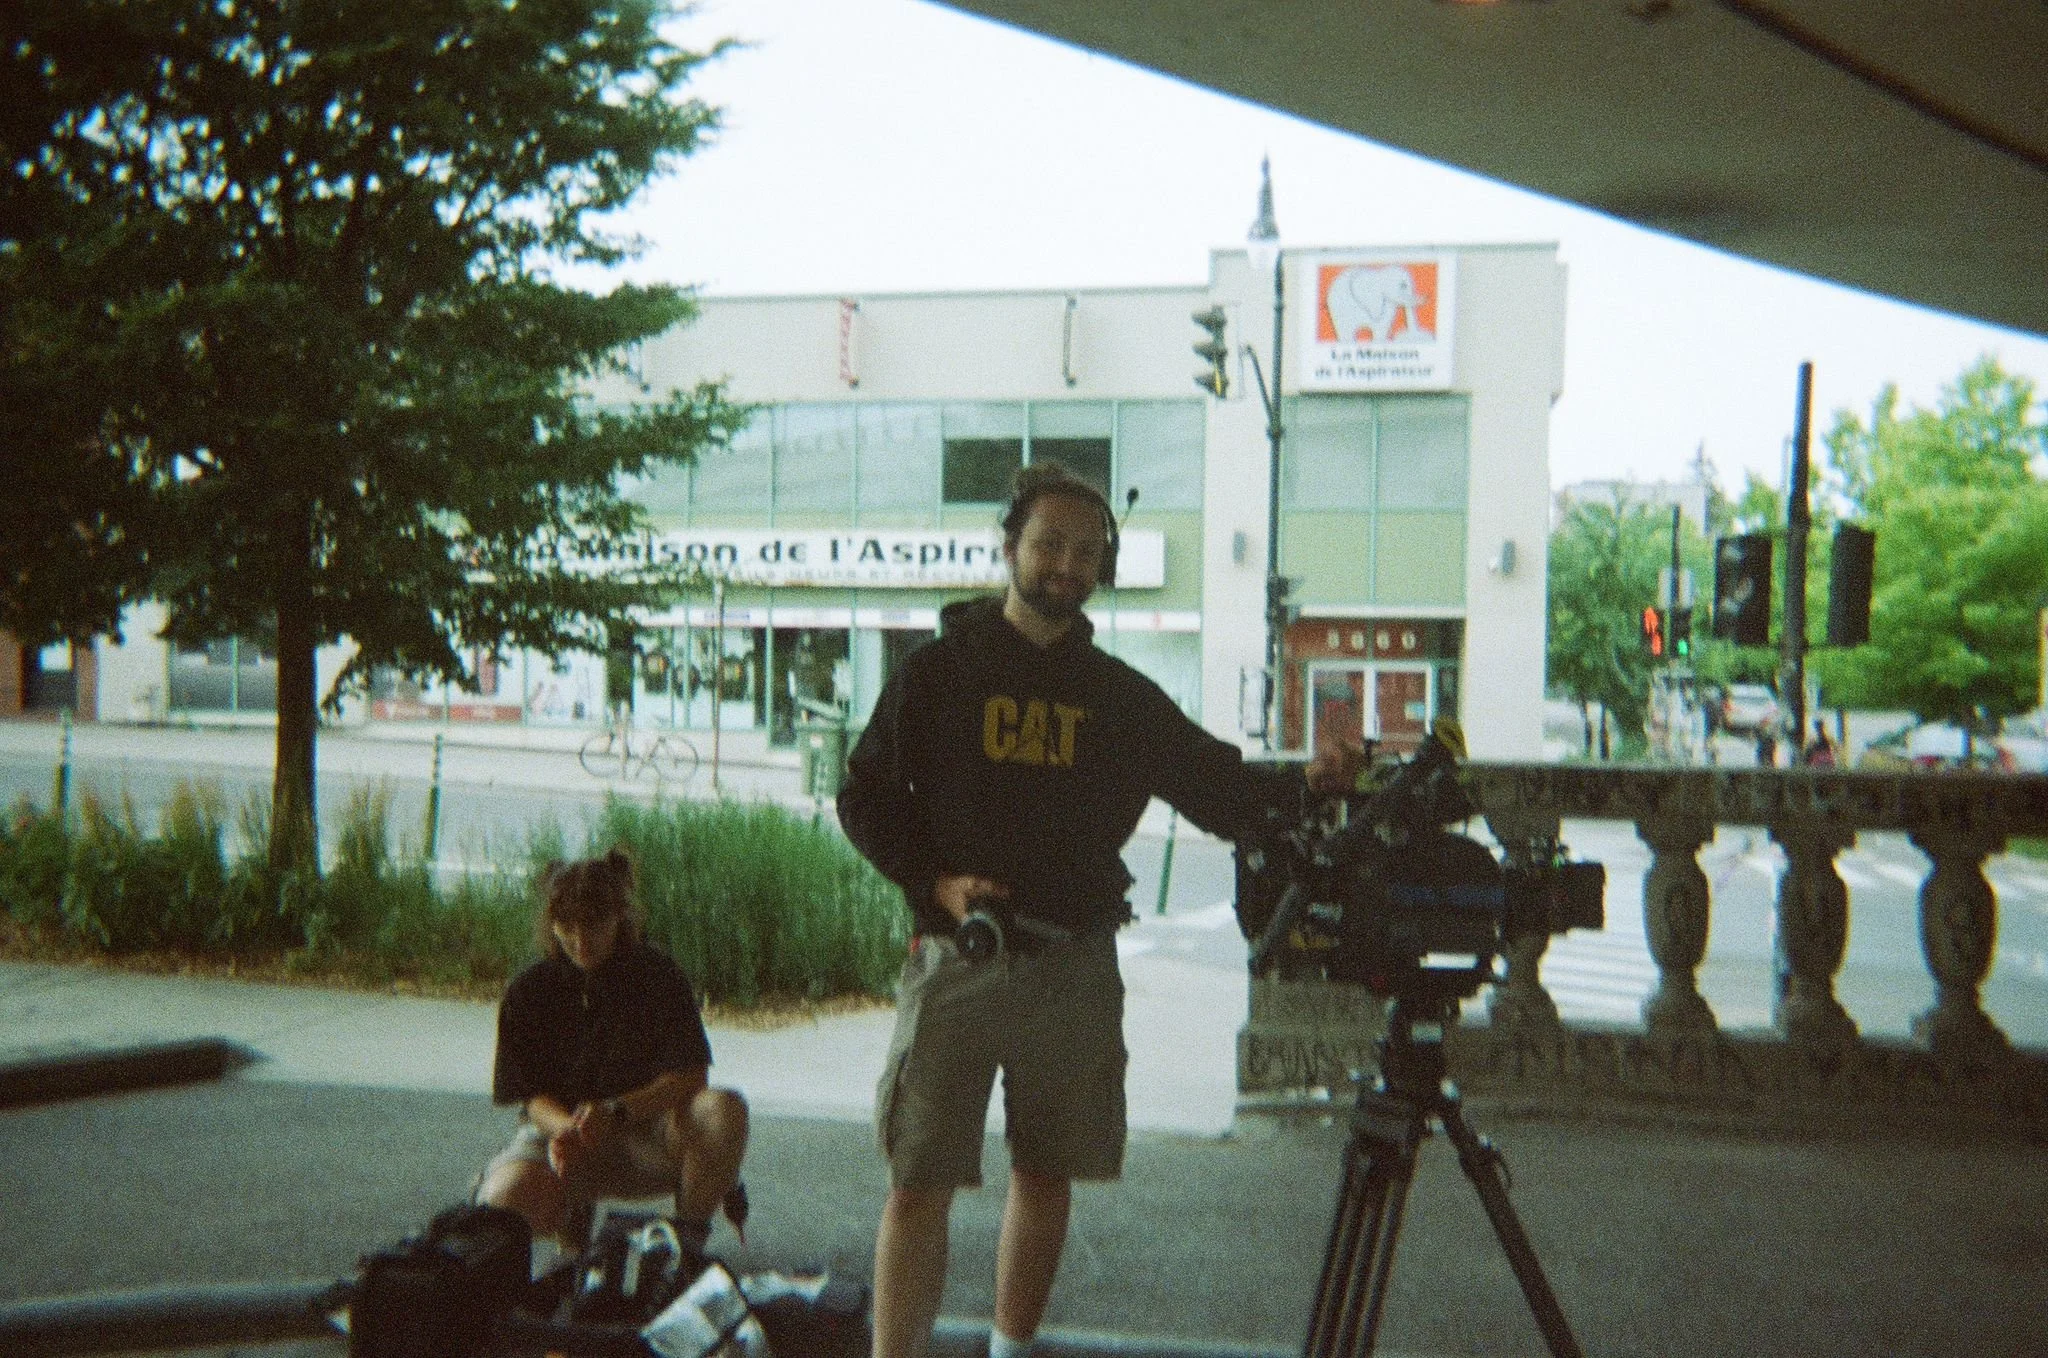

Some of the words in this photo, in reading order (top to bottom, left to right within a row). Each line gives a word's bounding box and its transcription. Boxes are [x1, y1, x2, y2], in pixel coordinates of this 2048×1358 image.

[1357, 349, 1419, 361] Maison
[759, 539, 807, 563] de
[983, 695, 1084, 767] CAT
